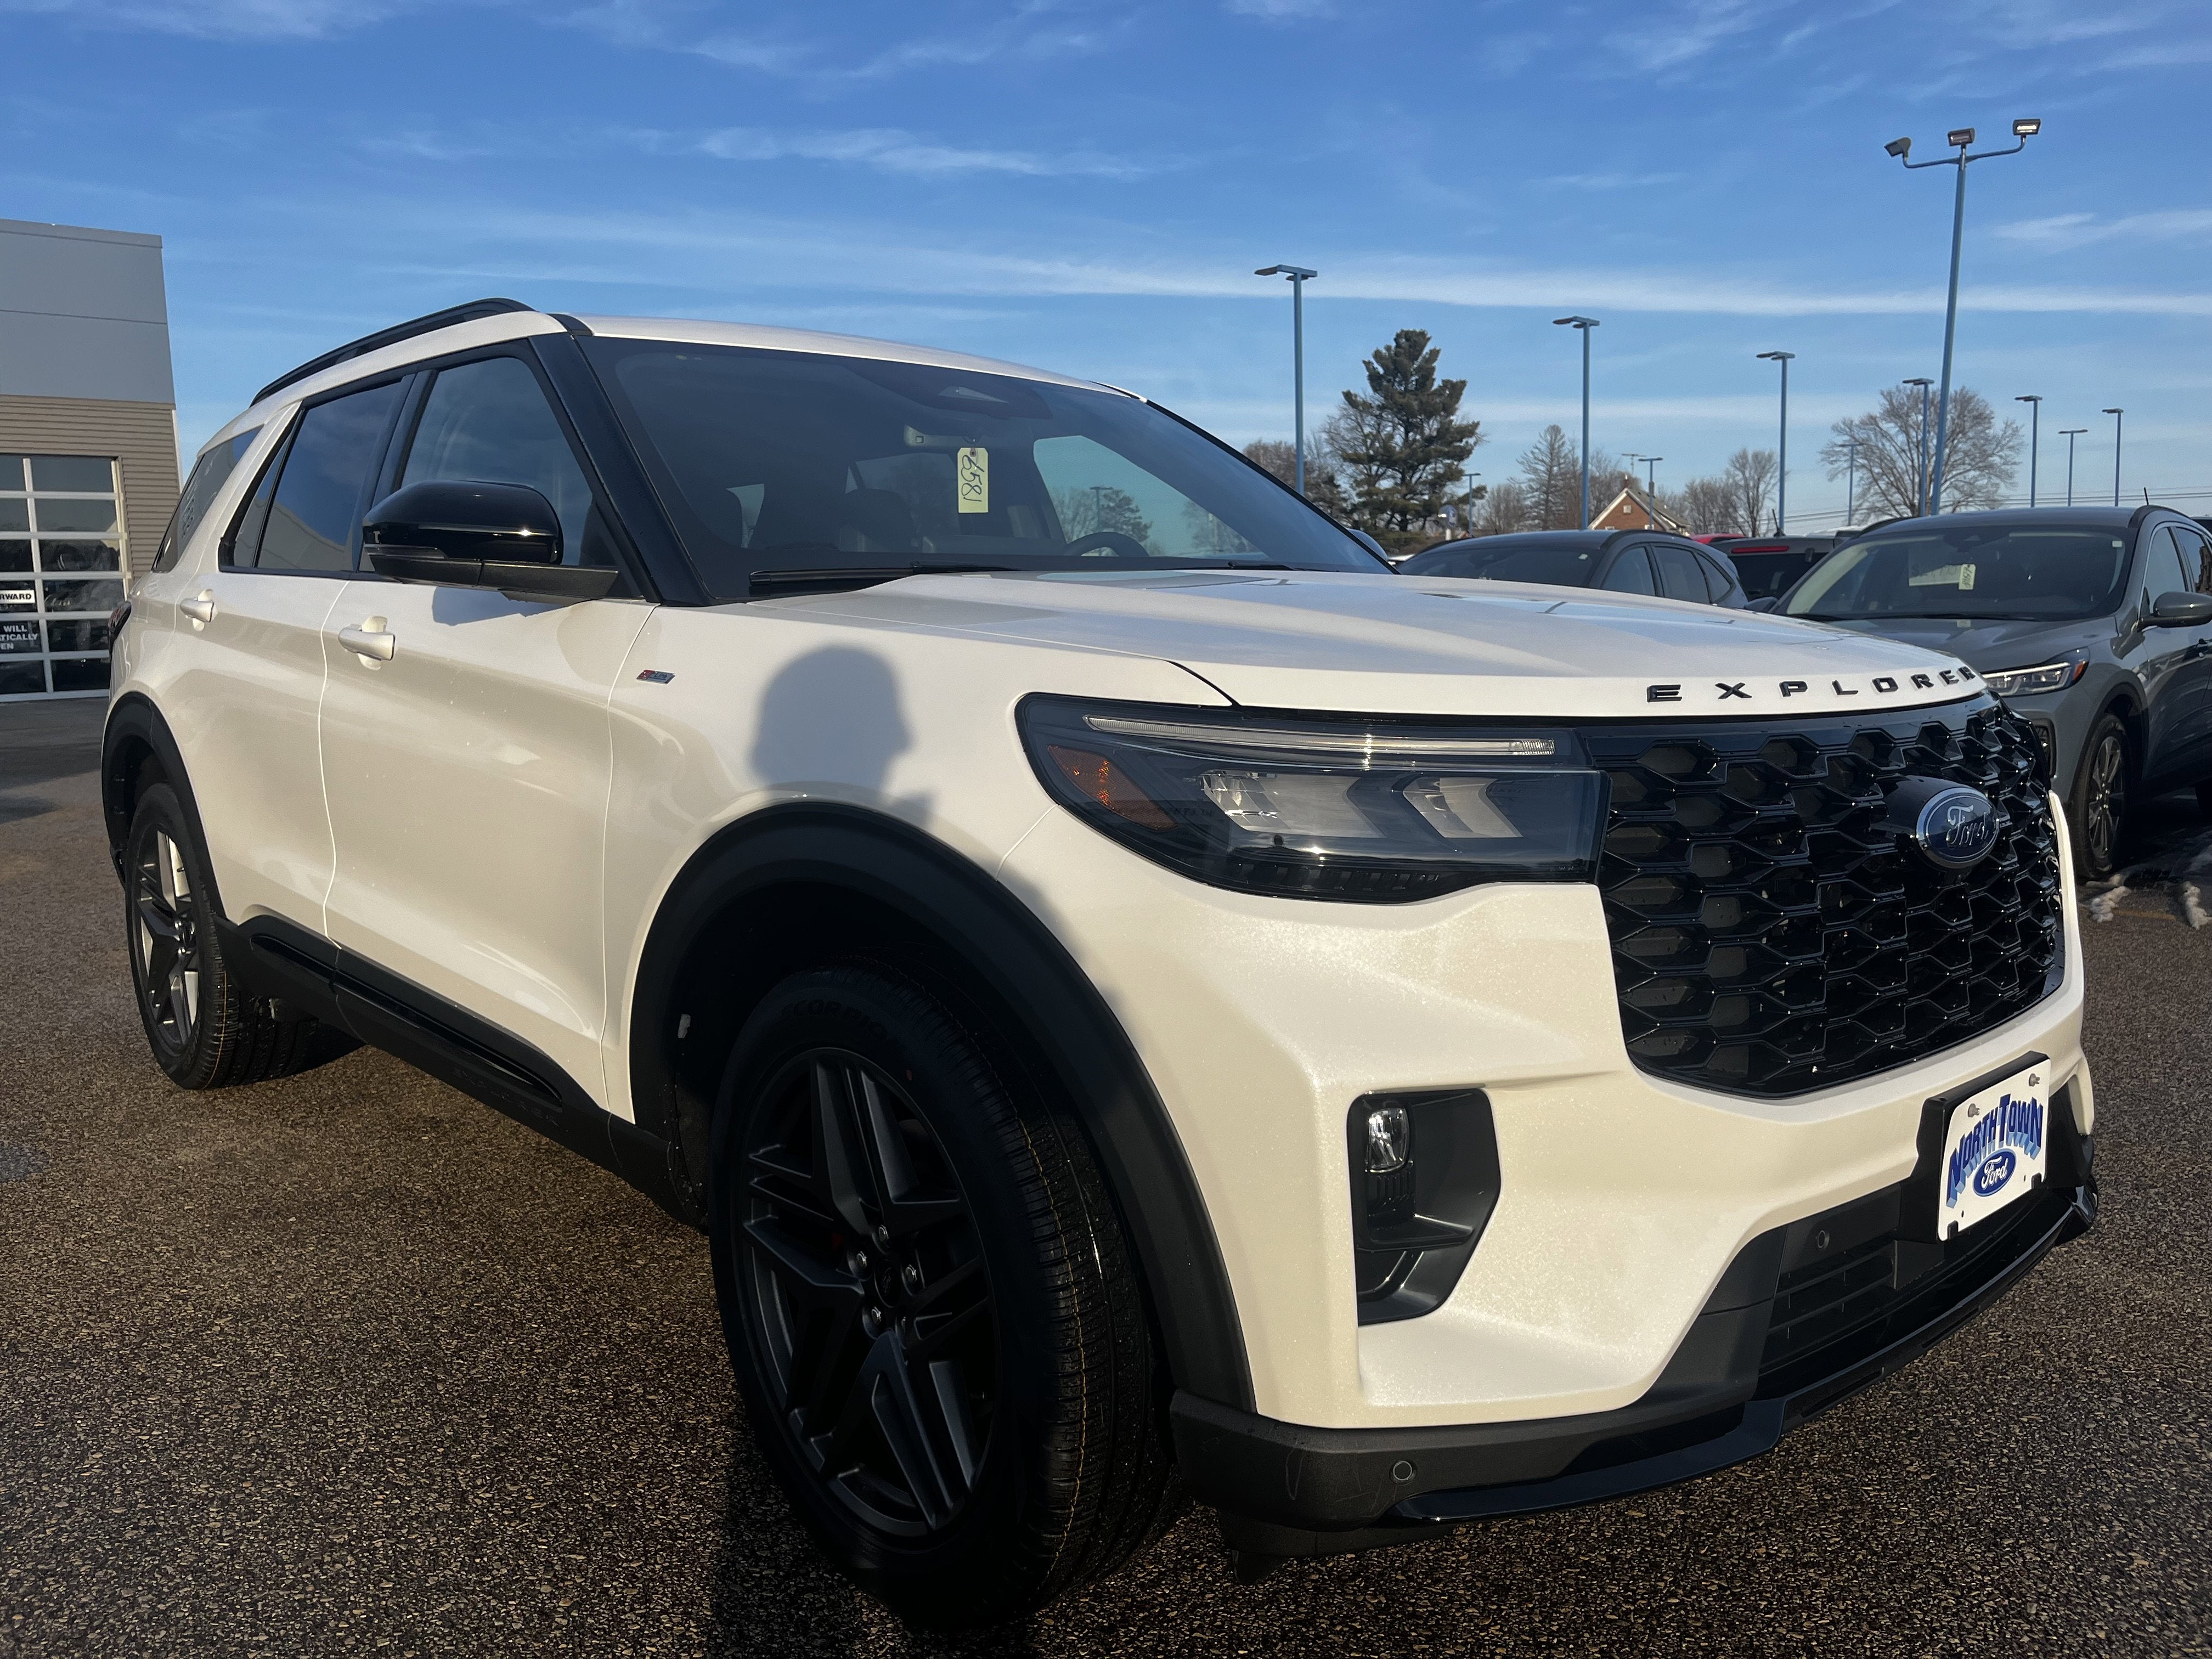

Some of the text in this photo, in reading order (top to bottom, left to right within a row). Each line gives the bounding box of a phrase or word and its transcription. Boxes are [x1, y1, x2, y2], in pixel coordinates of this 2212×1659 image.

[961, 454, 985, 502] 6581
[1646, 665, 1976, 703] EXPLORER
[1981, 1155, 2008, 1189] Ford
